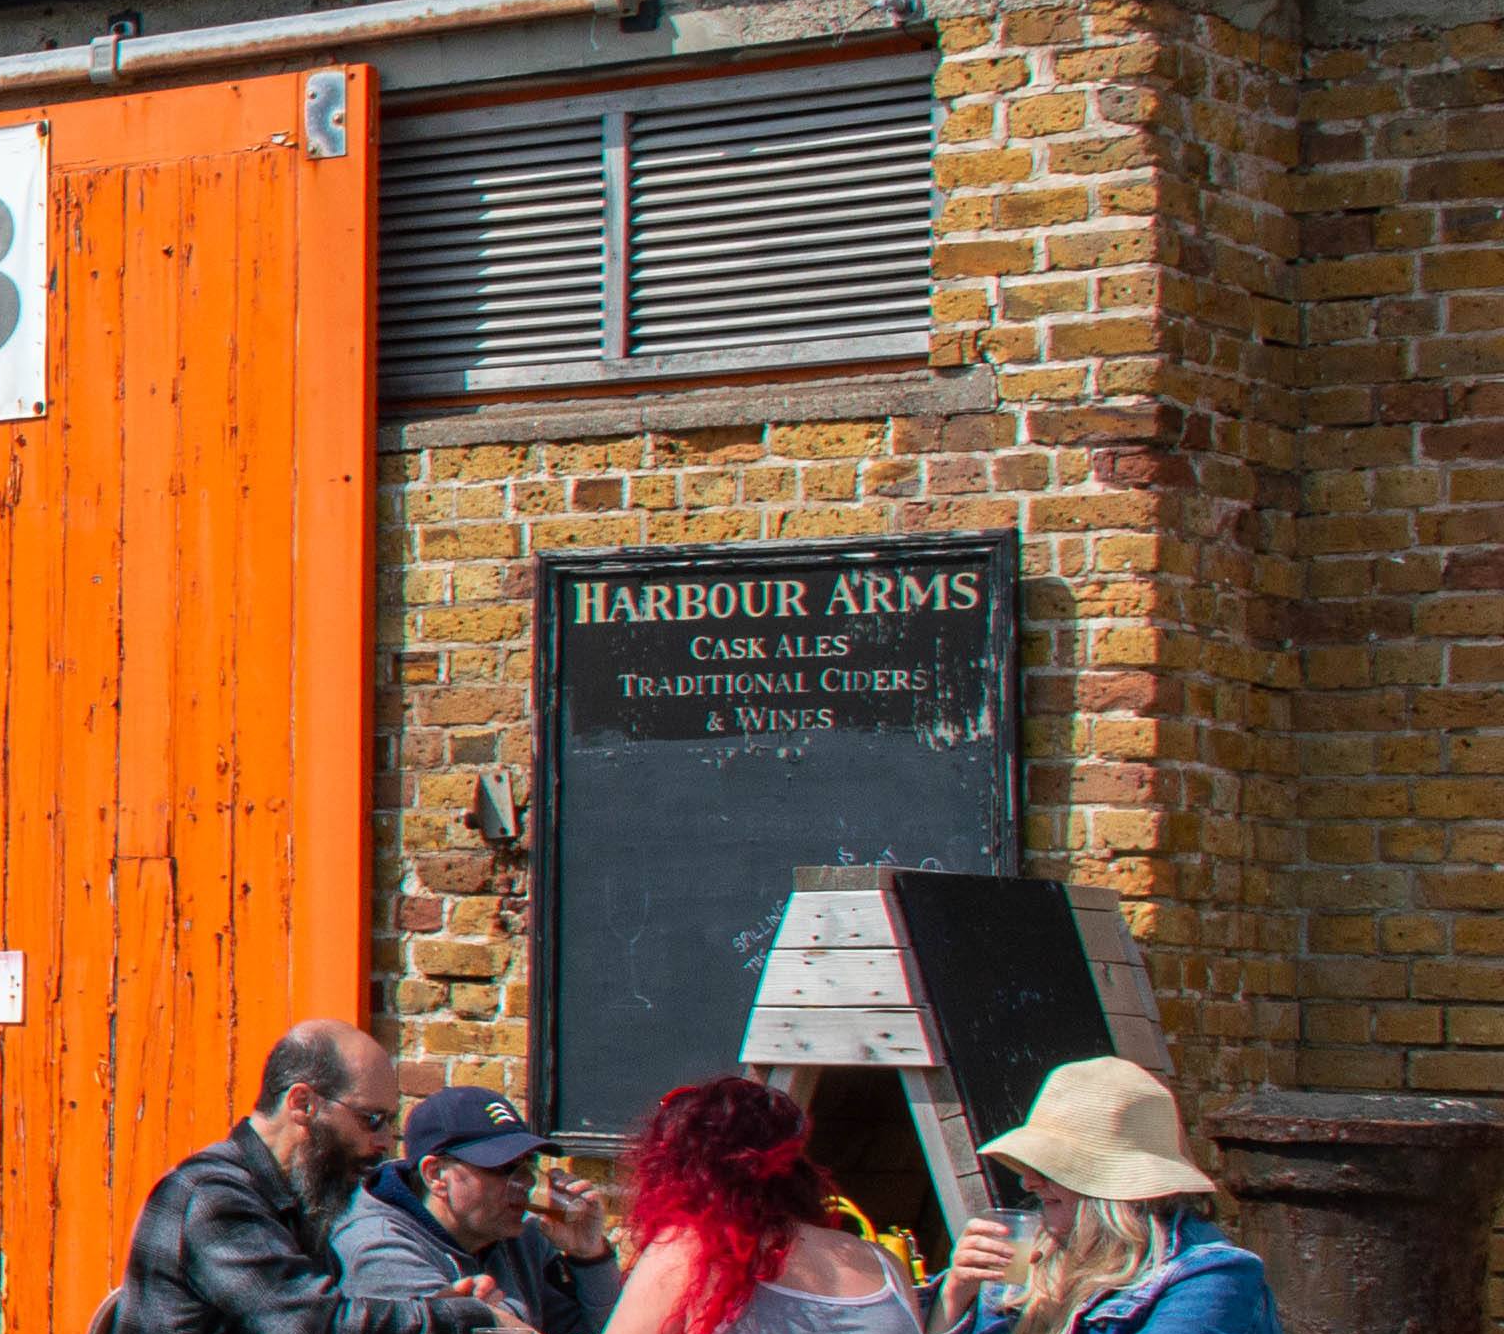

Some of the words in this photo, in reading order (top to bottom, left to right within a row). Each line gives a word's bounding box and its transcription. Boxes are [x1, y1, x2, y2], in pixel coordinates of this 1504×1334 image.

[574, 579, 808, 625] HARBOUR
[824, 571, 979, 616] ARMS
[690, 635, 767, 660] CASK
[774, 633, 851, 658] ALES
[617, 669, 812, 698] TRADITIONAL
[819, 667, 927, 692] CIDERS
[705, 710, 725, 731] &
[734, 705, 835, 732] WINES
